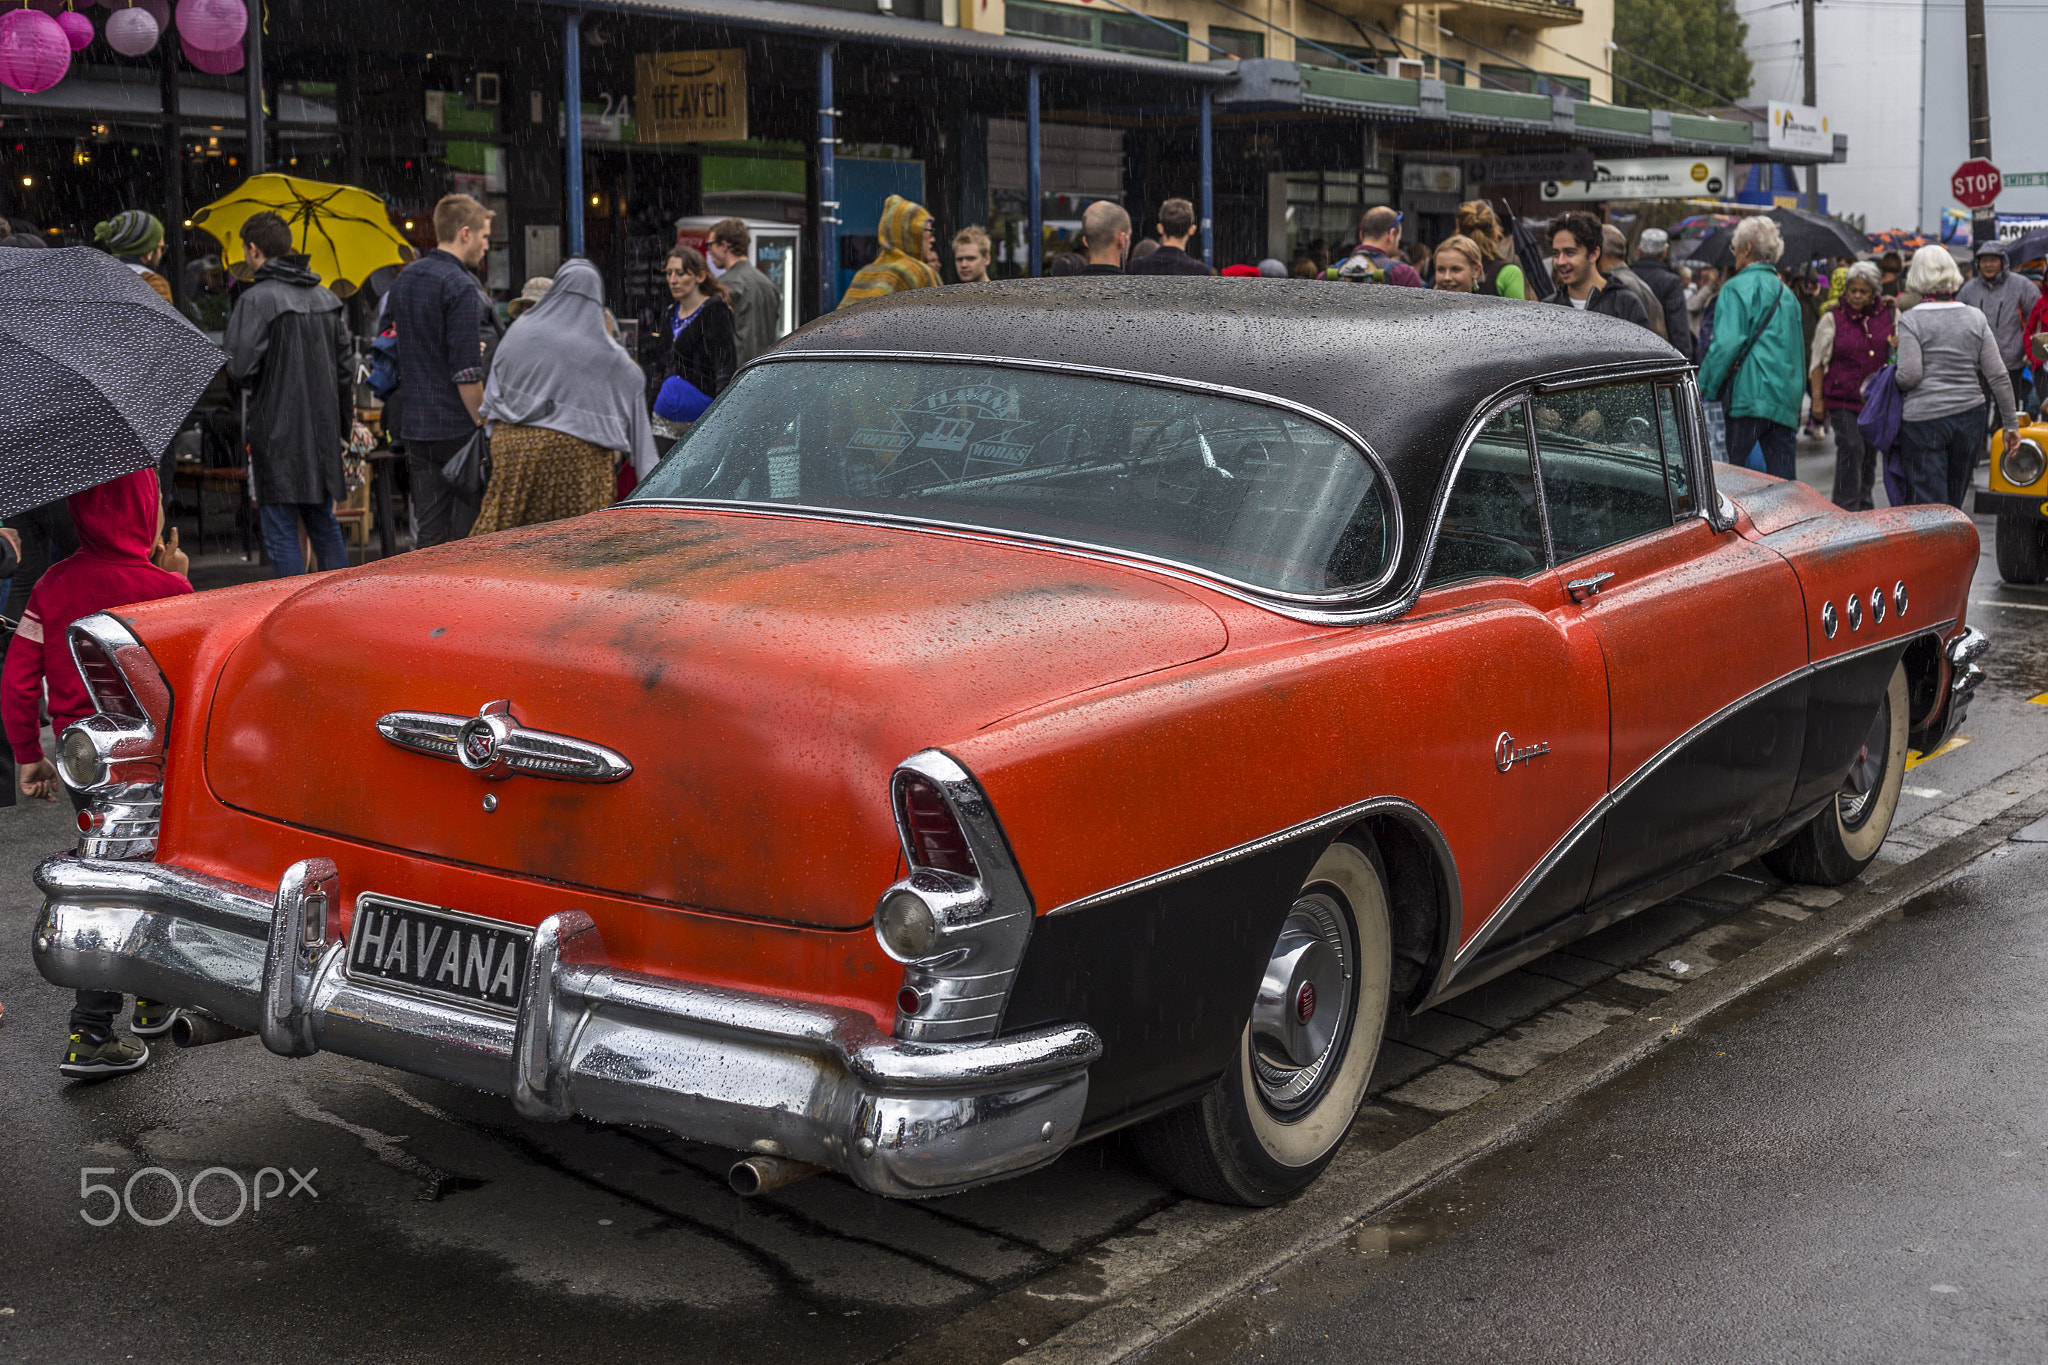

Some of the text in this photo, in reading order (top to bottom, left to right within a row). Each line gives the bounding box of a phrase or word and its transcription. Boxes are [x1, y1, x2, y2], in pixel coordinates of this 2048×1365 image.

[600, 92, 636, 126] 24
[652, 82, 727, 119] HEAVEN
[1954, 173, 1999, 196] STOP
[2004, 175, 2033, 186] SMITH
[853, 432, 911, 448] COFFEE
[973, 443, 1028, 461] WORKS
[357, 911, 516, 998] HAVANA
